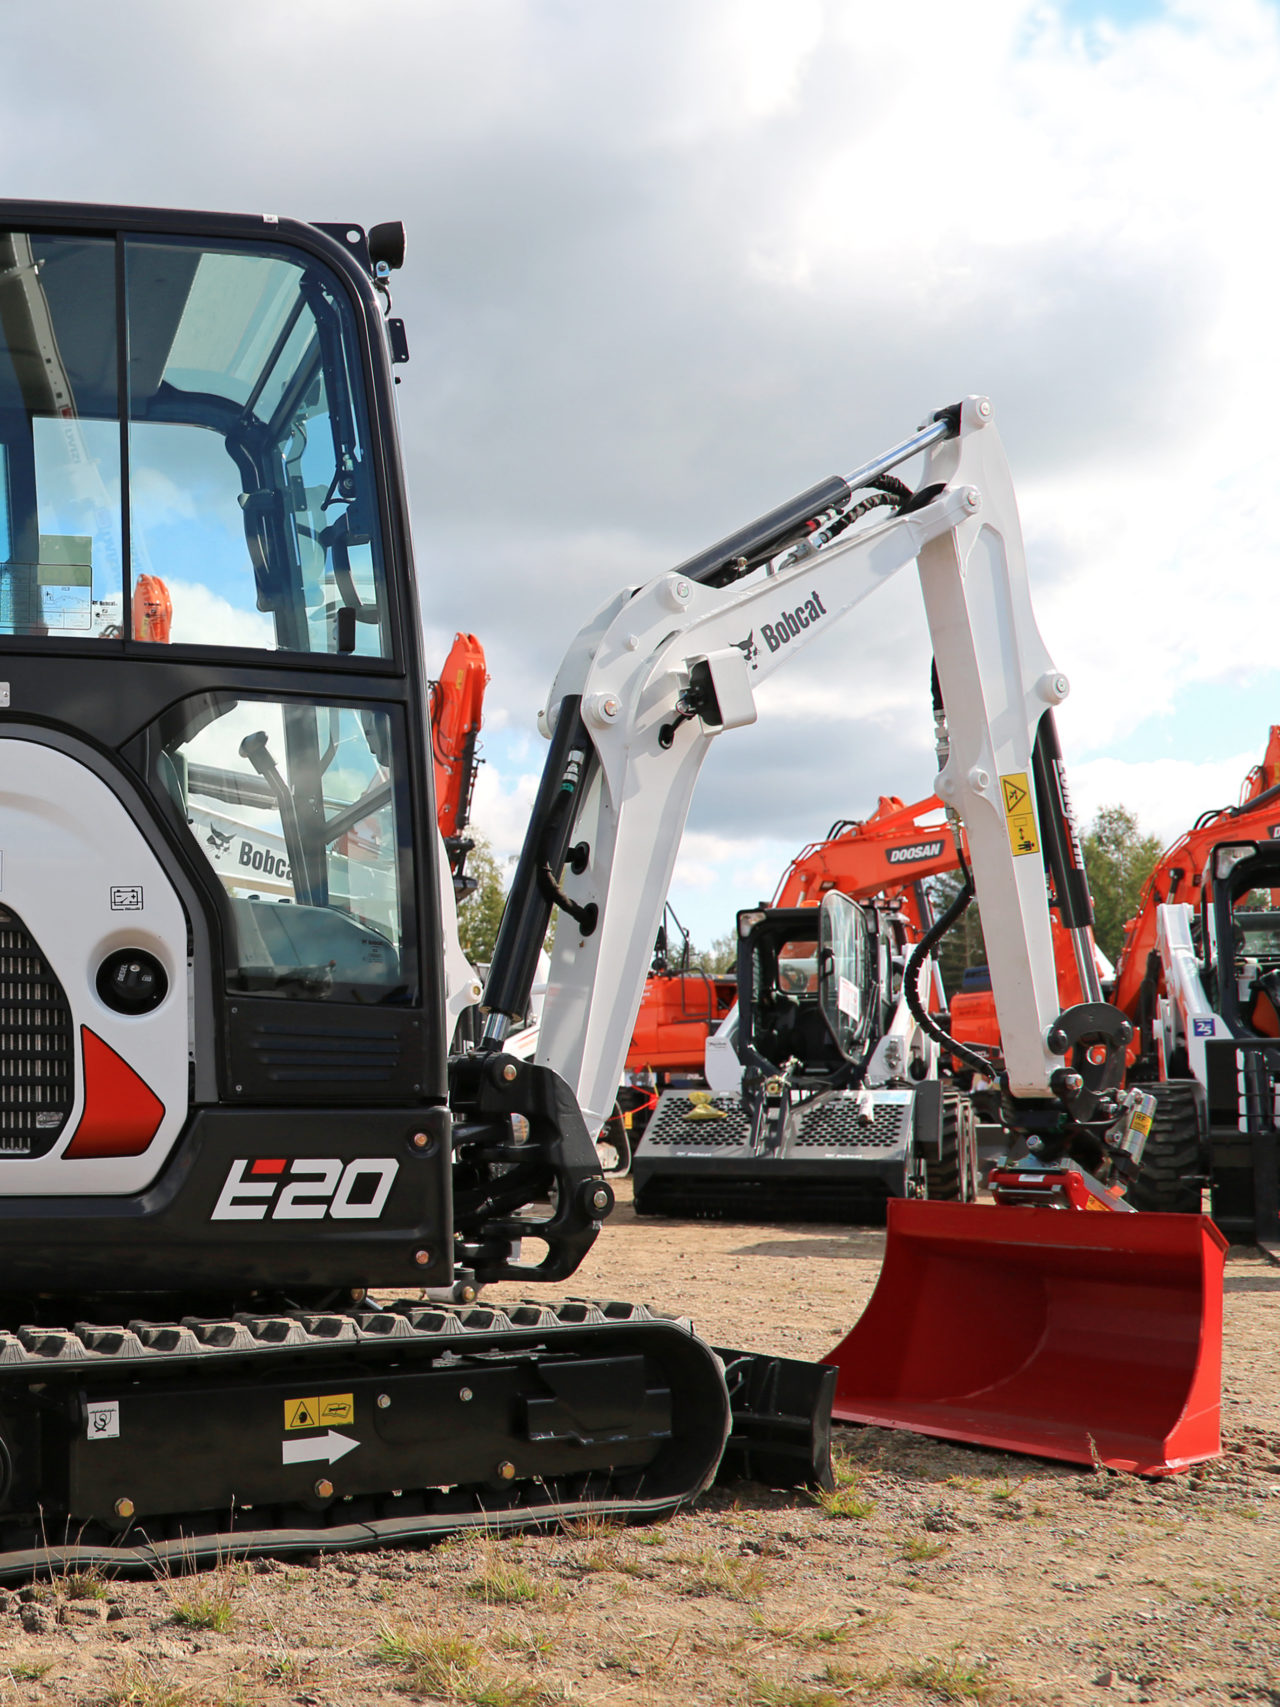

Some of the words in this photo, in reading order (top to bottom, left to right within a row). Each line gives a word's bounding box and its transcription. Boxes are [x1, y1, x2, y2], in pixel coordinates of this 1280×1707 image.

[760, 590, 827, 653] Bobcat
[238, 840, 295, 881] Bobca
[890, 843, 941, 862] DOOSAN
[1197, 1022, 1212, 1036] 25
[210, 1158, 399, 1220] E20
